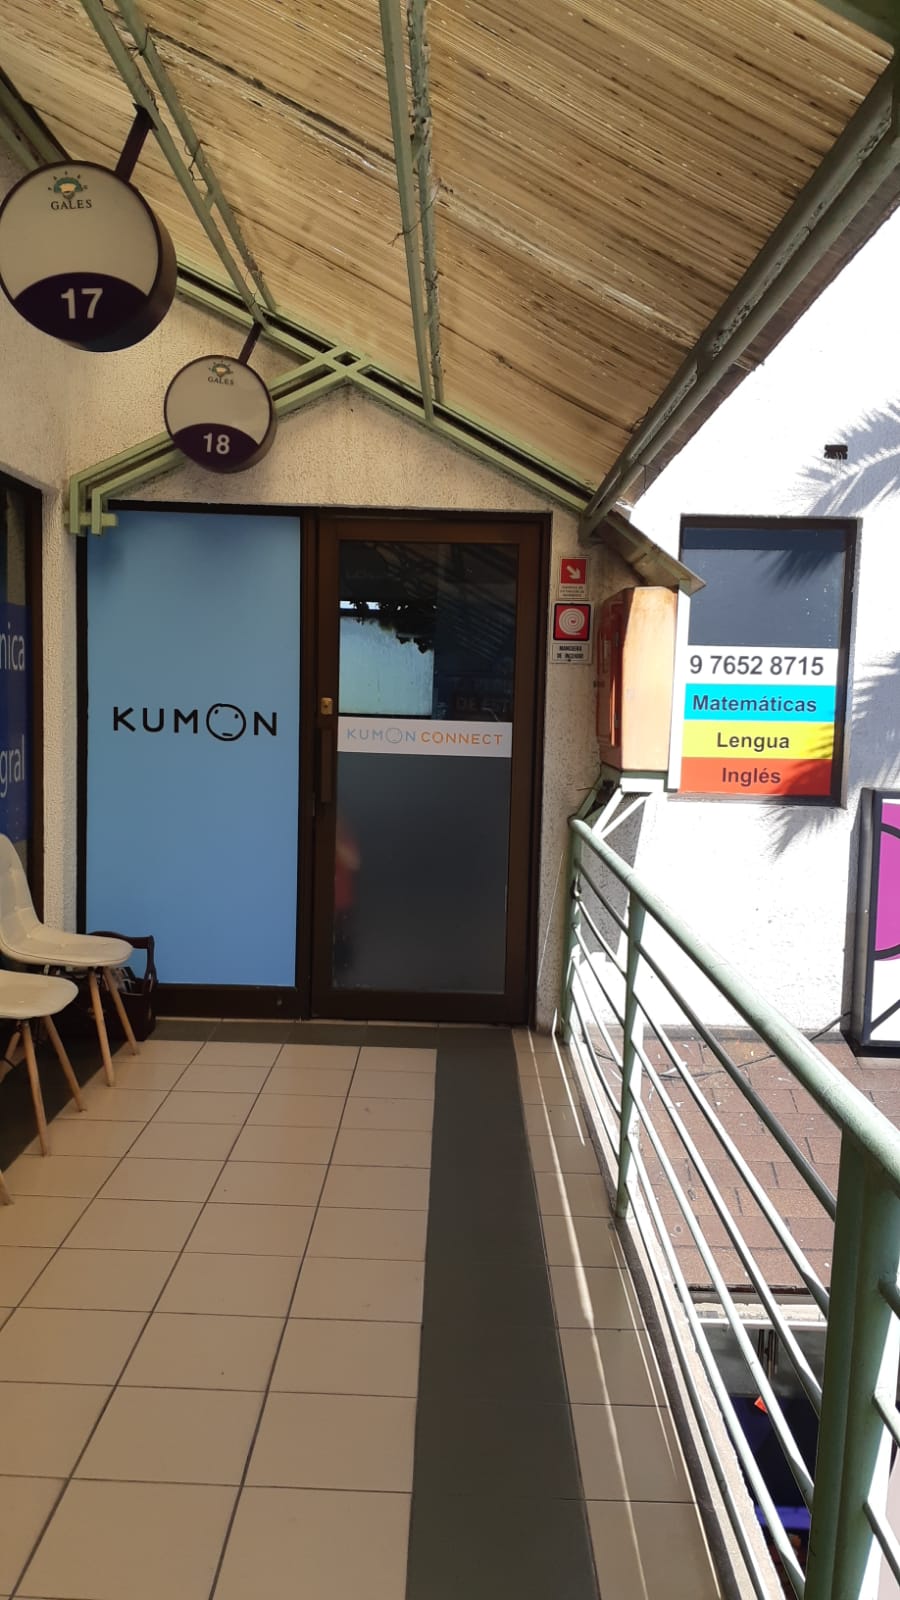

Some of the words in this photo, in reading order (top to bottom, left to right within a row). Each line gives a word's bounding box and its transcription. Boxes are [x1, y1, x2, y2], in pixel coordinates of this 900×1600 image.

[51, 199, 92, 211] GALES
[61, 287, 103, 319] 17
[207, 375, 234, 386] GALES
[203, 432, 230, 454] 18
[690, 655, 702, 674] 9
[710, 655, 763, 675] 7652
[770, 656, 824, 676] 8715
[692, 695, 817, 712] Matemáticas
[113, 703, 277, 741] KUMON
[347, 727, 417, 744] KUMON
[420, 731, 503, 745] CONNECT
[717, 732, 790, 752] Lengua
[0, 734, 25, 798] gral
[722, 767, 781, 787] Inglés
